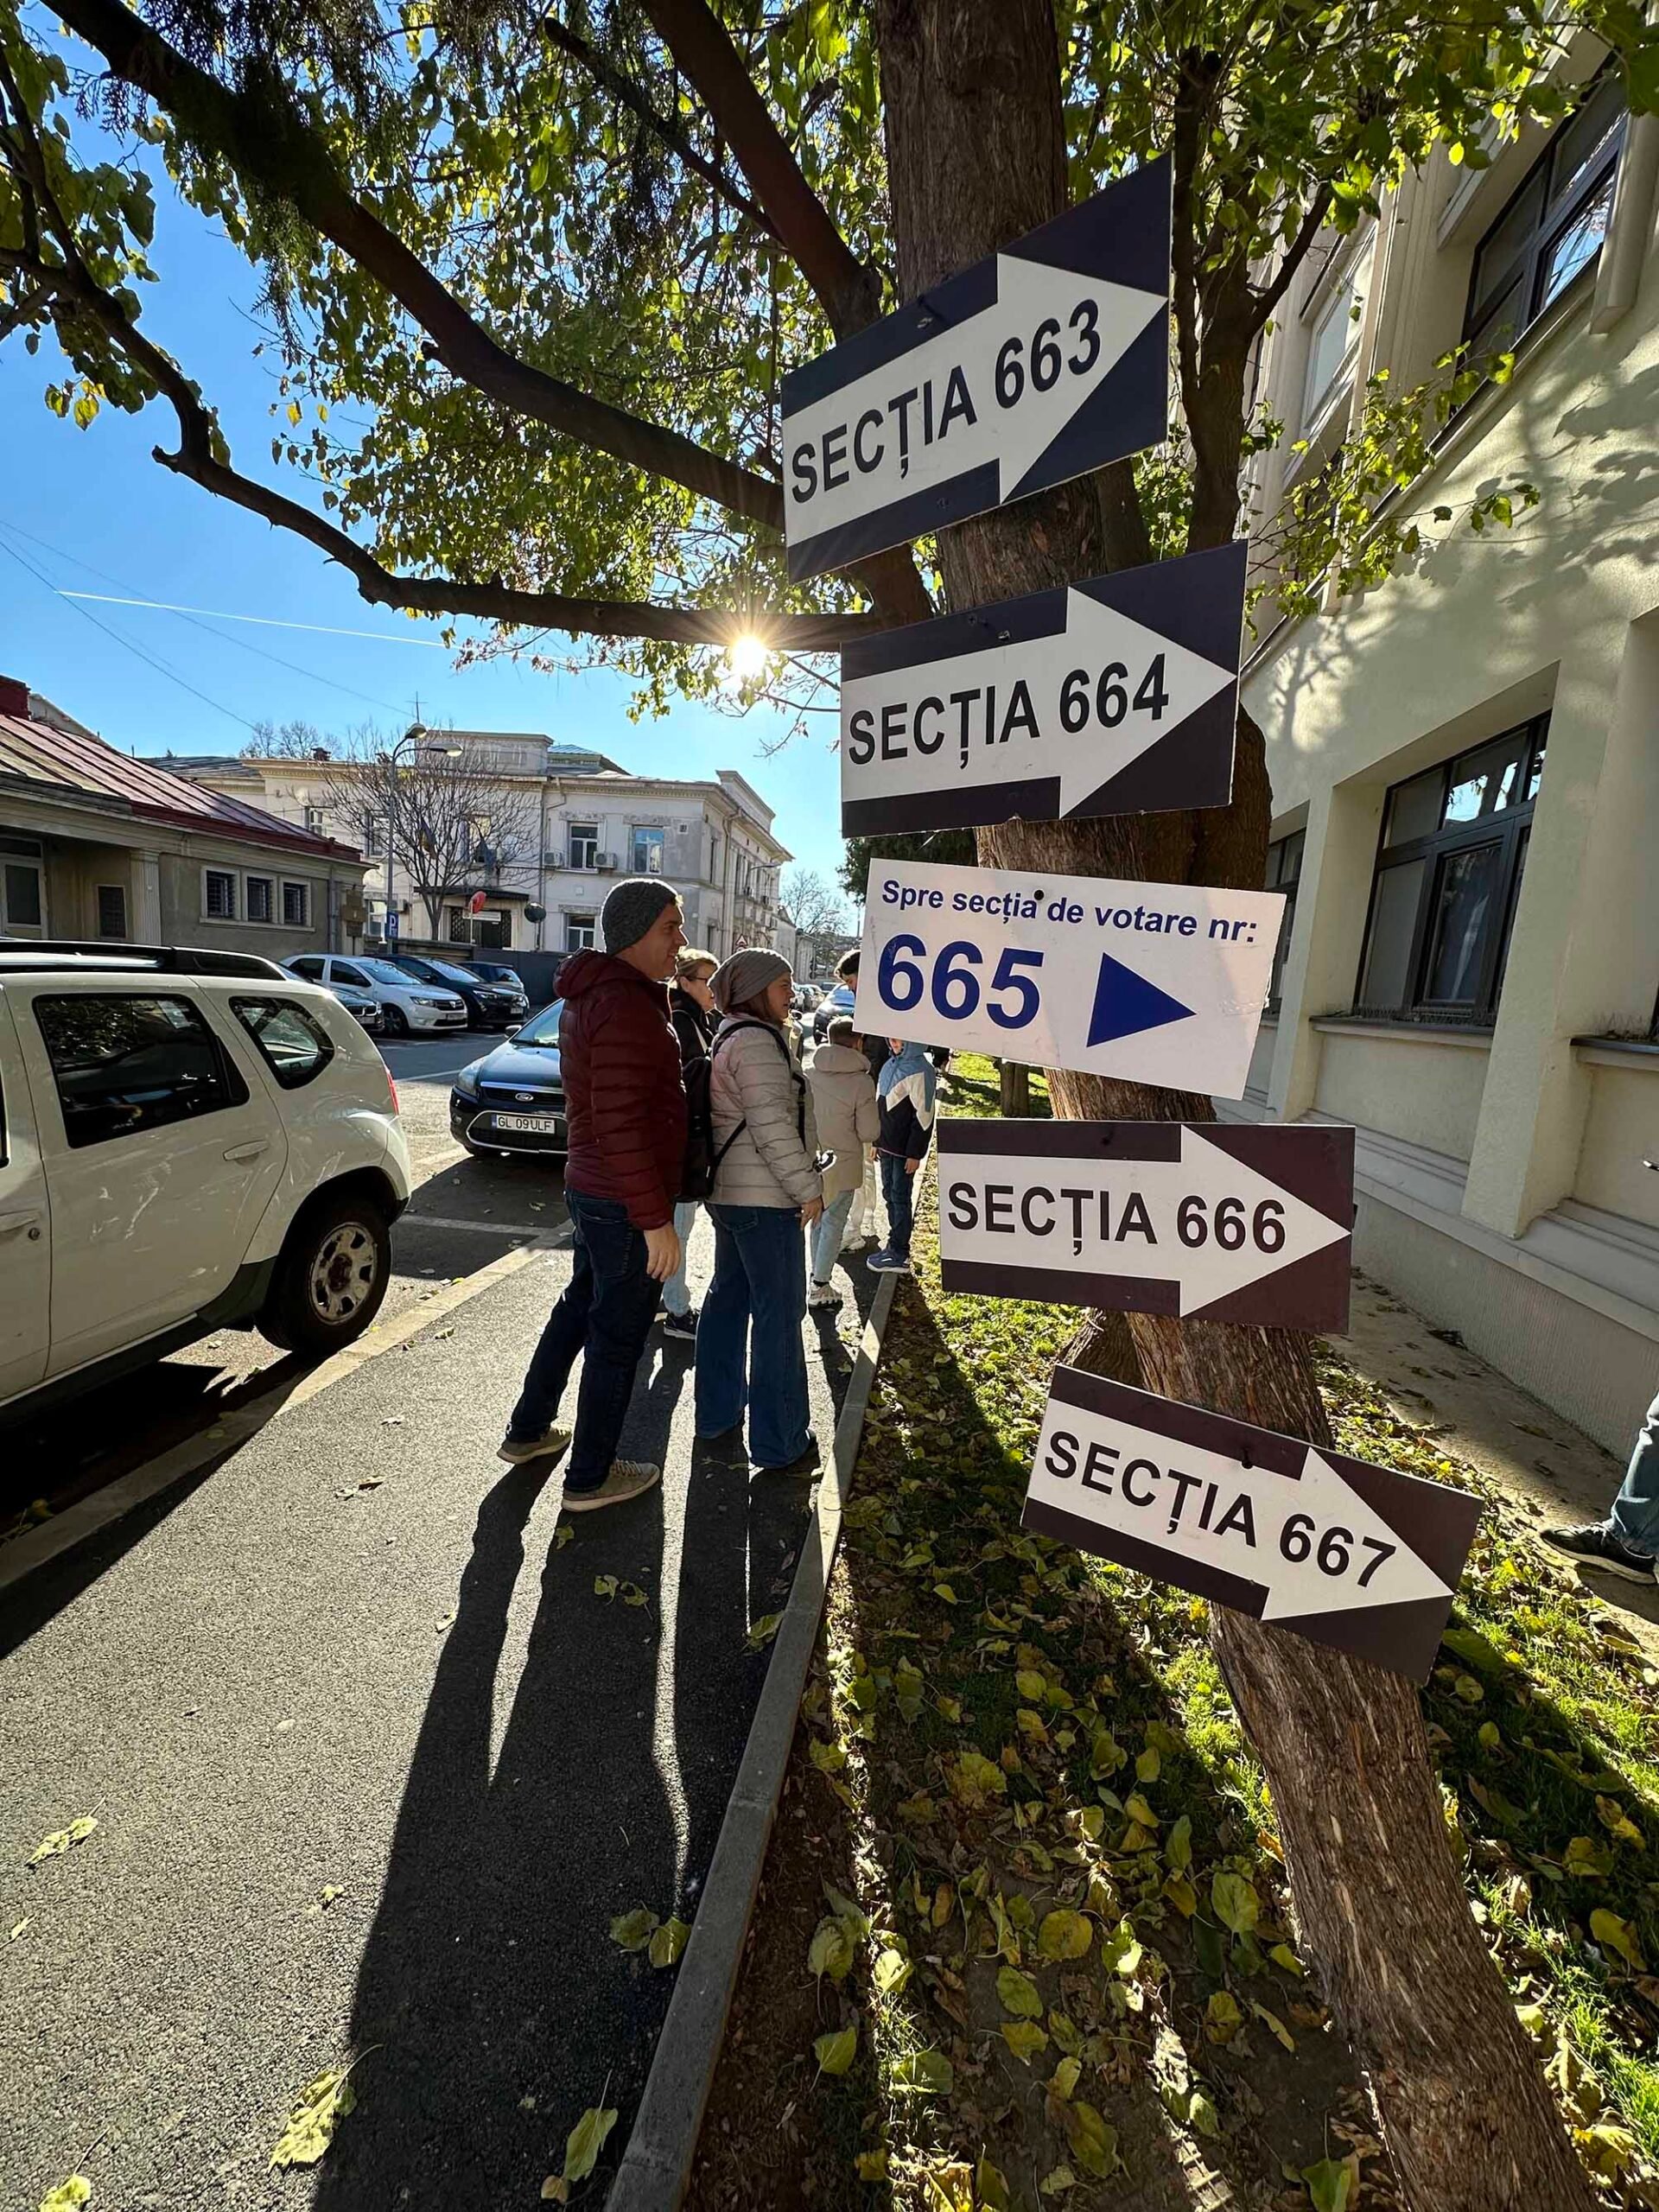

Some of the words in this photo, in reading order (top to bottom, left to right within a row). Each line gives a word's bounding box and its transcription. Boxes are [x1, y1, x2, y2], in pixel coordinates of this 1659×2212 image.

[791, 365, 978, 504] SECȚIA
[995, 298, 1101, 410] 663
[849, 679, 1041, 770] SECȚIA
[1059, 652, 1169, 734] 664
[881, 880, 944, 911] Spre
[951, 893, 1038, 924] secția
[1046, 897, 1084, 924] de
[1094, 906, 1198, 937] votare
[1208, 918, 1257, 943] nr:
[877, 933, 1045, 1030] 665
[498, 1116, 512, 1128] GL
[516, 1118, 530, 1129] 09
[530, 1119, 552, 1132] ULF
[948, 1182, 1159, 1256] SECȚIA
[1176, 1195, 1286, 1254] 666
[1045, 1431, 1256, 1548] SECȚIA
[1279, 1513, 1397, 1588] 667
